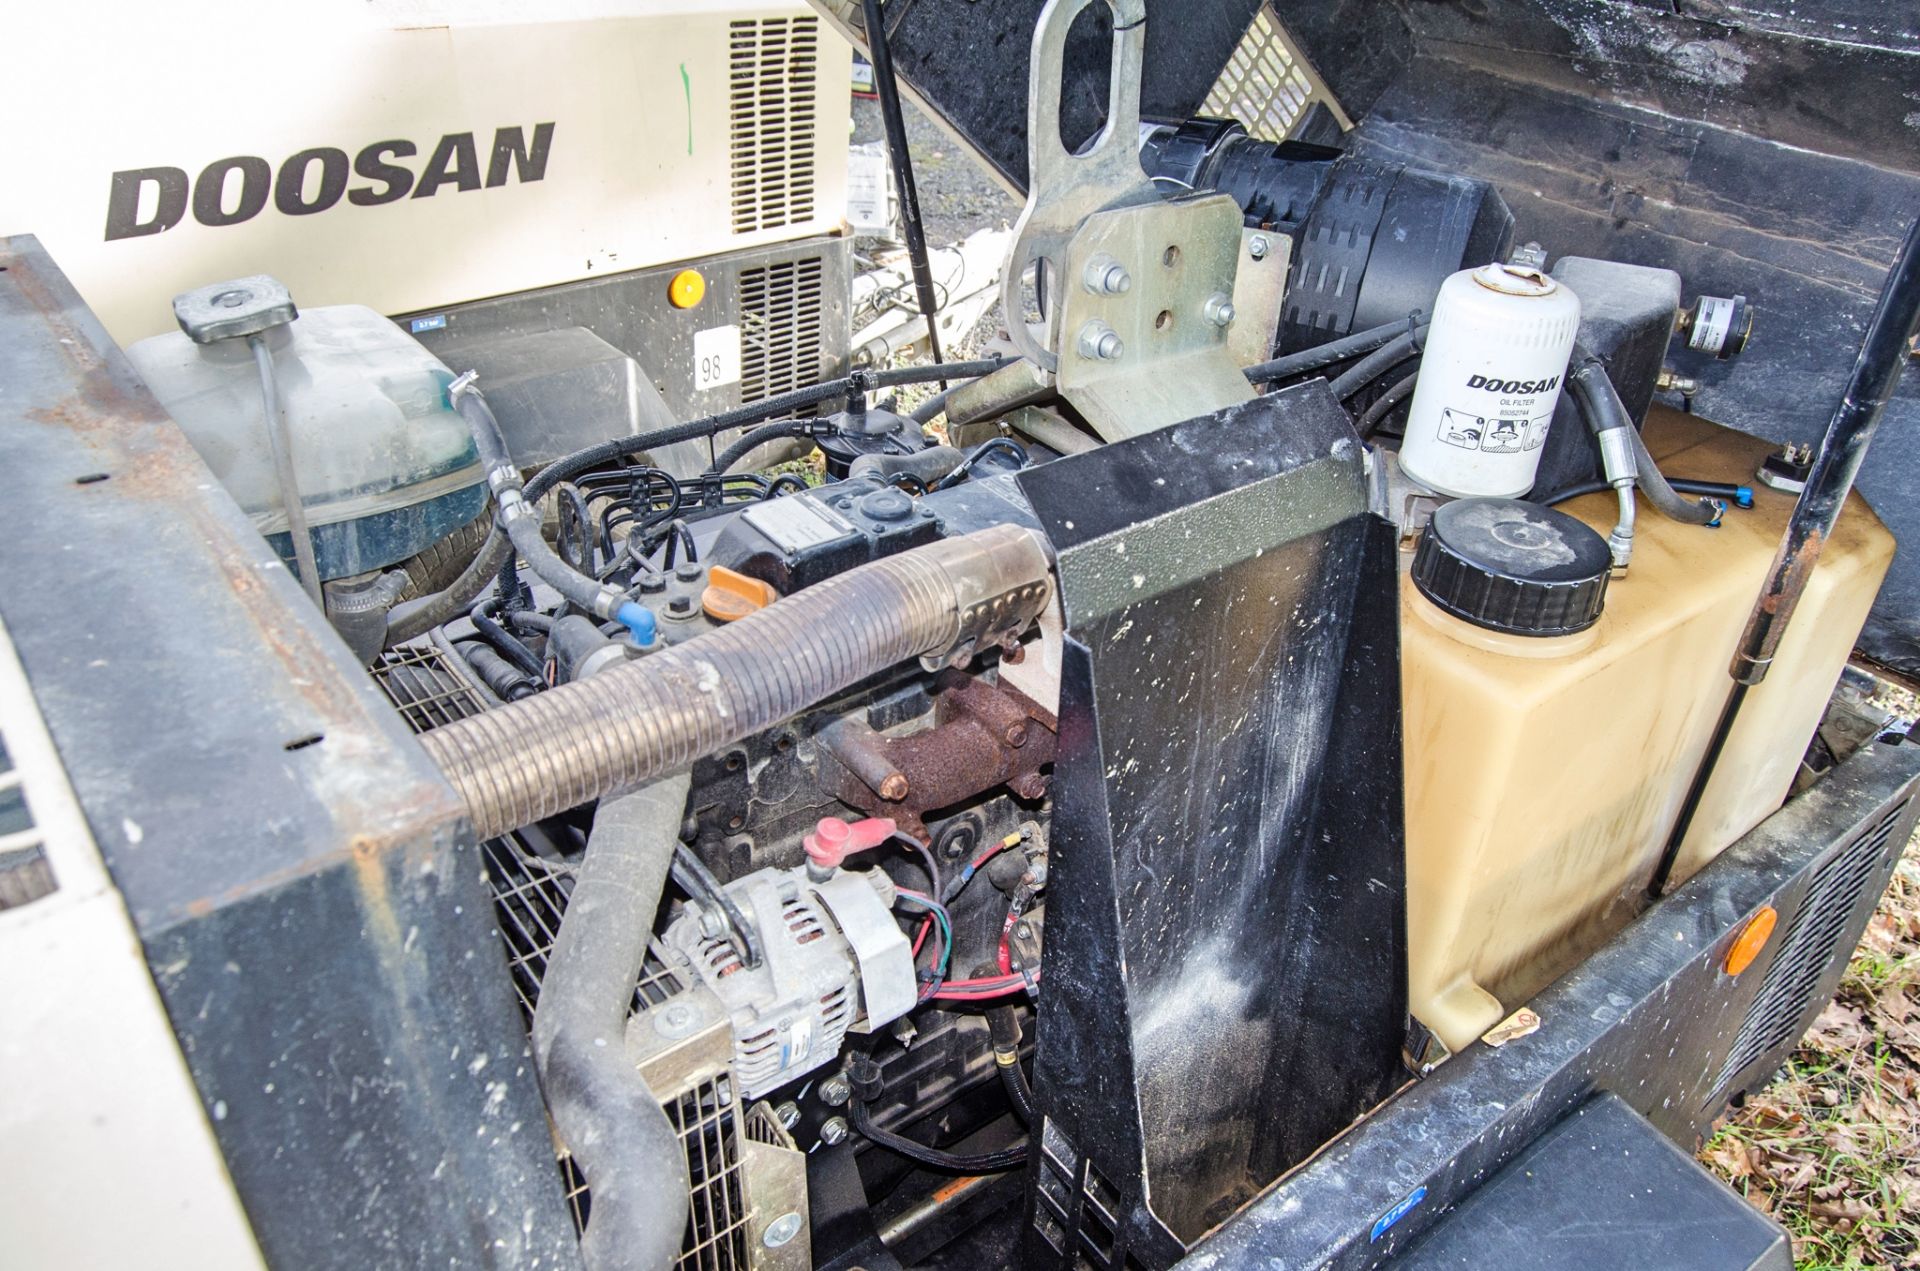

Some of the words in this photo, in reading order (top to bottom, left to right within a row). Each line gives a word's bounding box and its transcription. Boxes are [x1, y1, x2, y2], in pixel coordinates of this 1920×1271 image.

[104, 122, 556, 242] DOOSAN
[702, 355, 721, 382] 98
[1466, 374, 1560, 394] DOOSAN
[1499, 398, 1511, 406] OIL
[1512, 398, 1535, 406] FILTER
